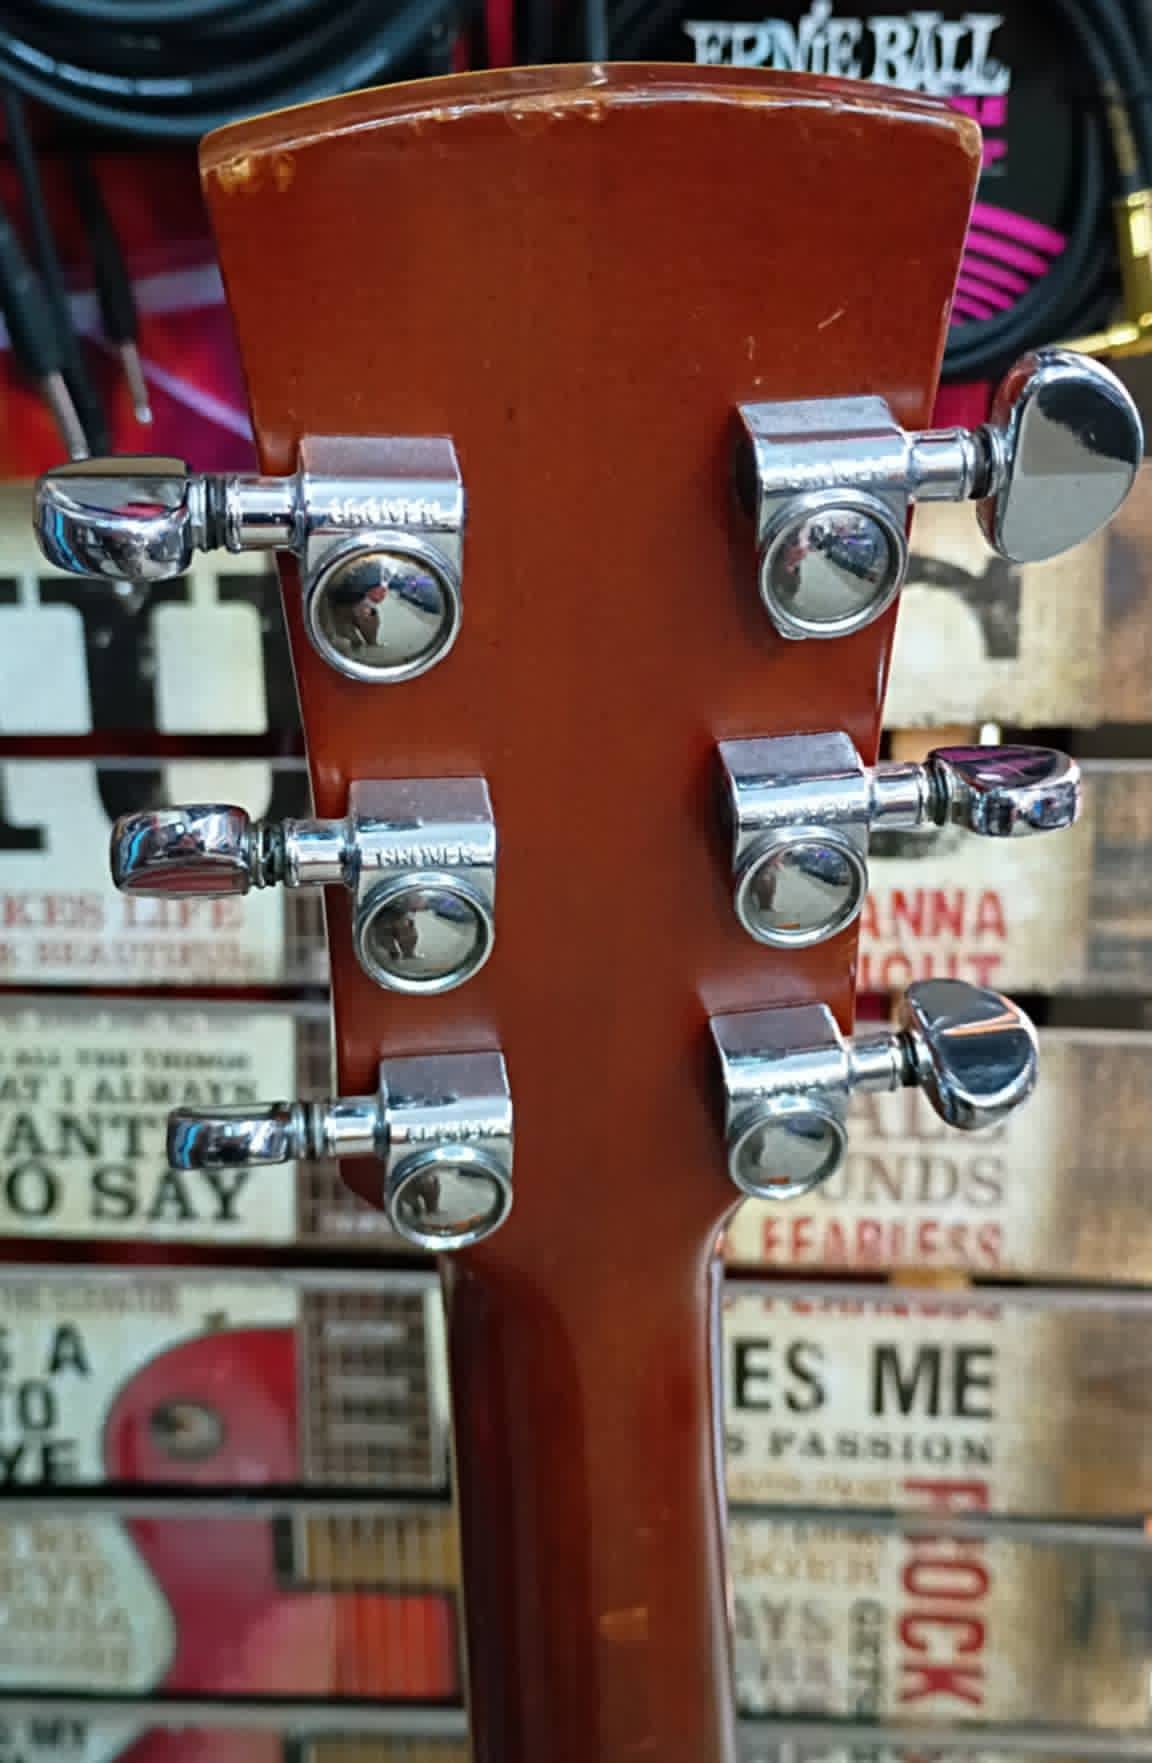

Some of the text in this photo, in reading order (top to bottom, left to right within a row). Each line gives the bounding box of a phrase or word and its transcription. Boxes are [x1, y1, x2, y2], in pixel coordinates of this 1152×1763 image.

[868, 10, 1011, 96] BALL
[0, 1160, 252, 1222] O SAY
[870, 1341, 997, 1418] ME
[768, 1430, 993, 1466] PASSION
